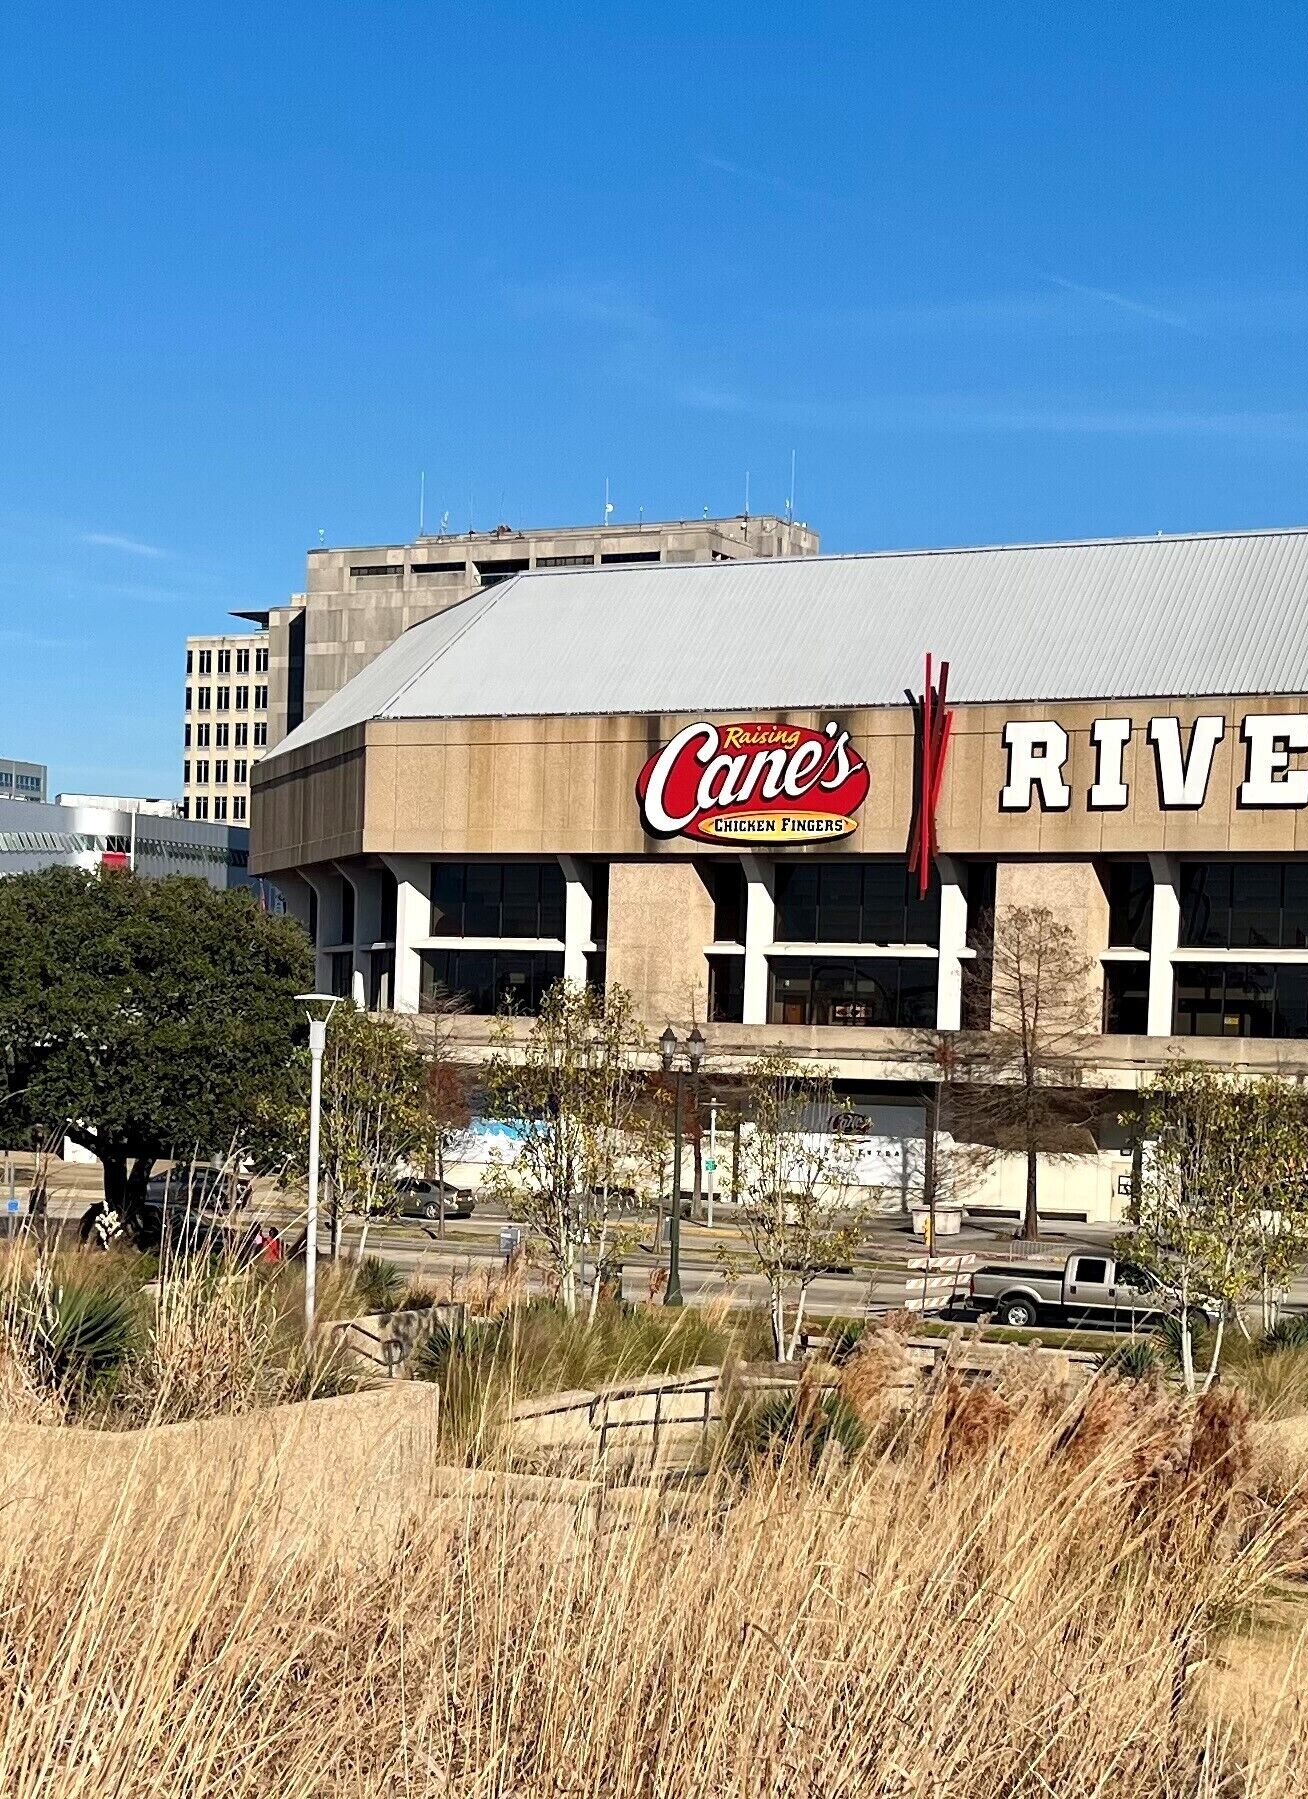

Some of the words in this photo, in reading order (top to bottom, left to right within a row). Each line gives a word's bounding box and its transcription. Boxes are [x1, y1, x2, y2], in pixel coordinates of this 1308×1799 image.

[723, 725, 801, 750] Raising
[644, 721, 864, 832] Cane's
[714, 818, 775, 832] CHICKEN
[781, 817, 843, 832] FINGERS
